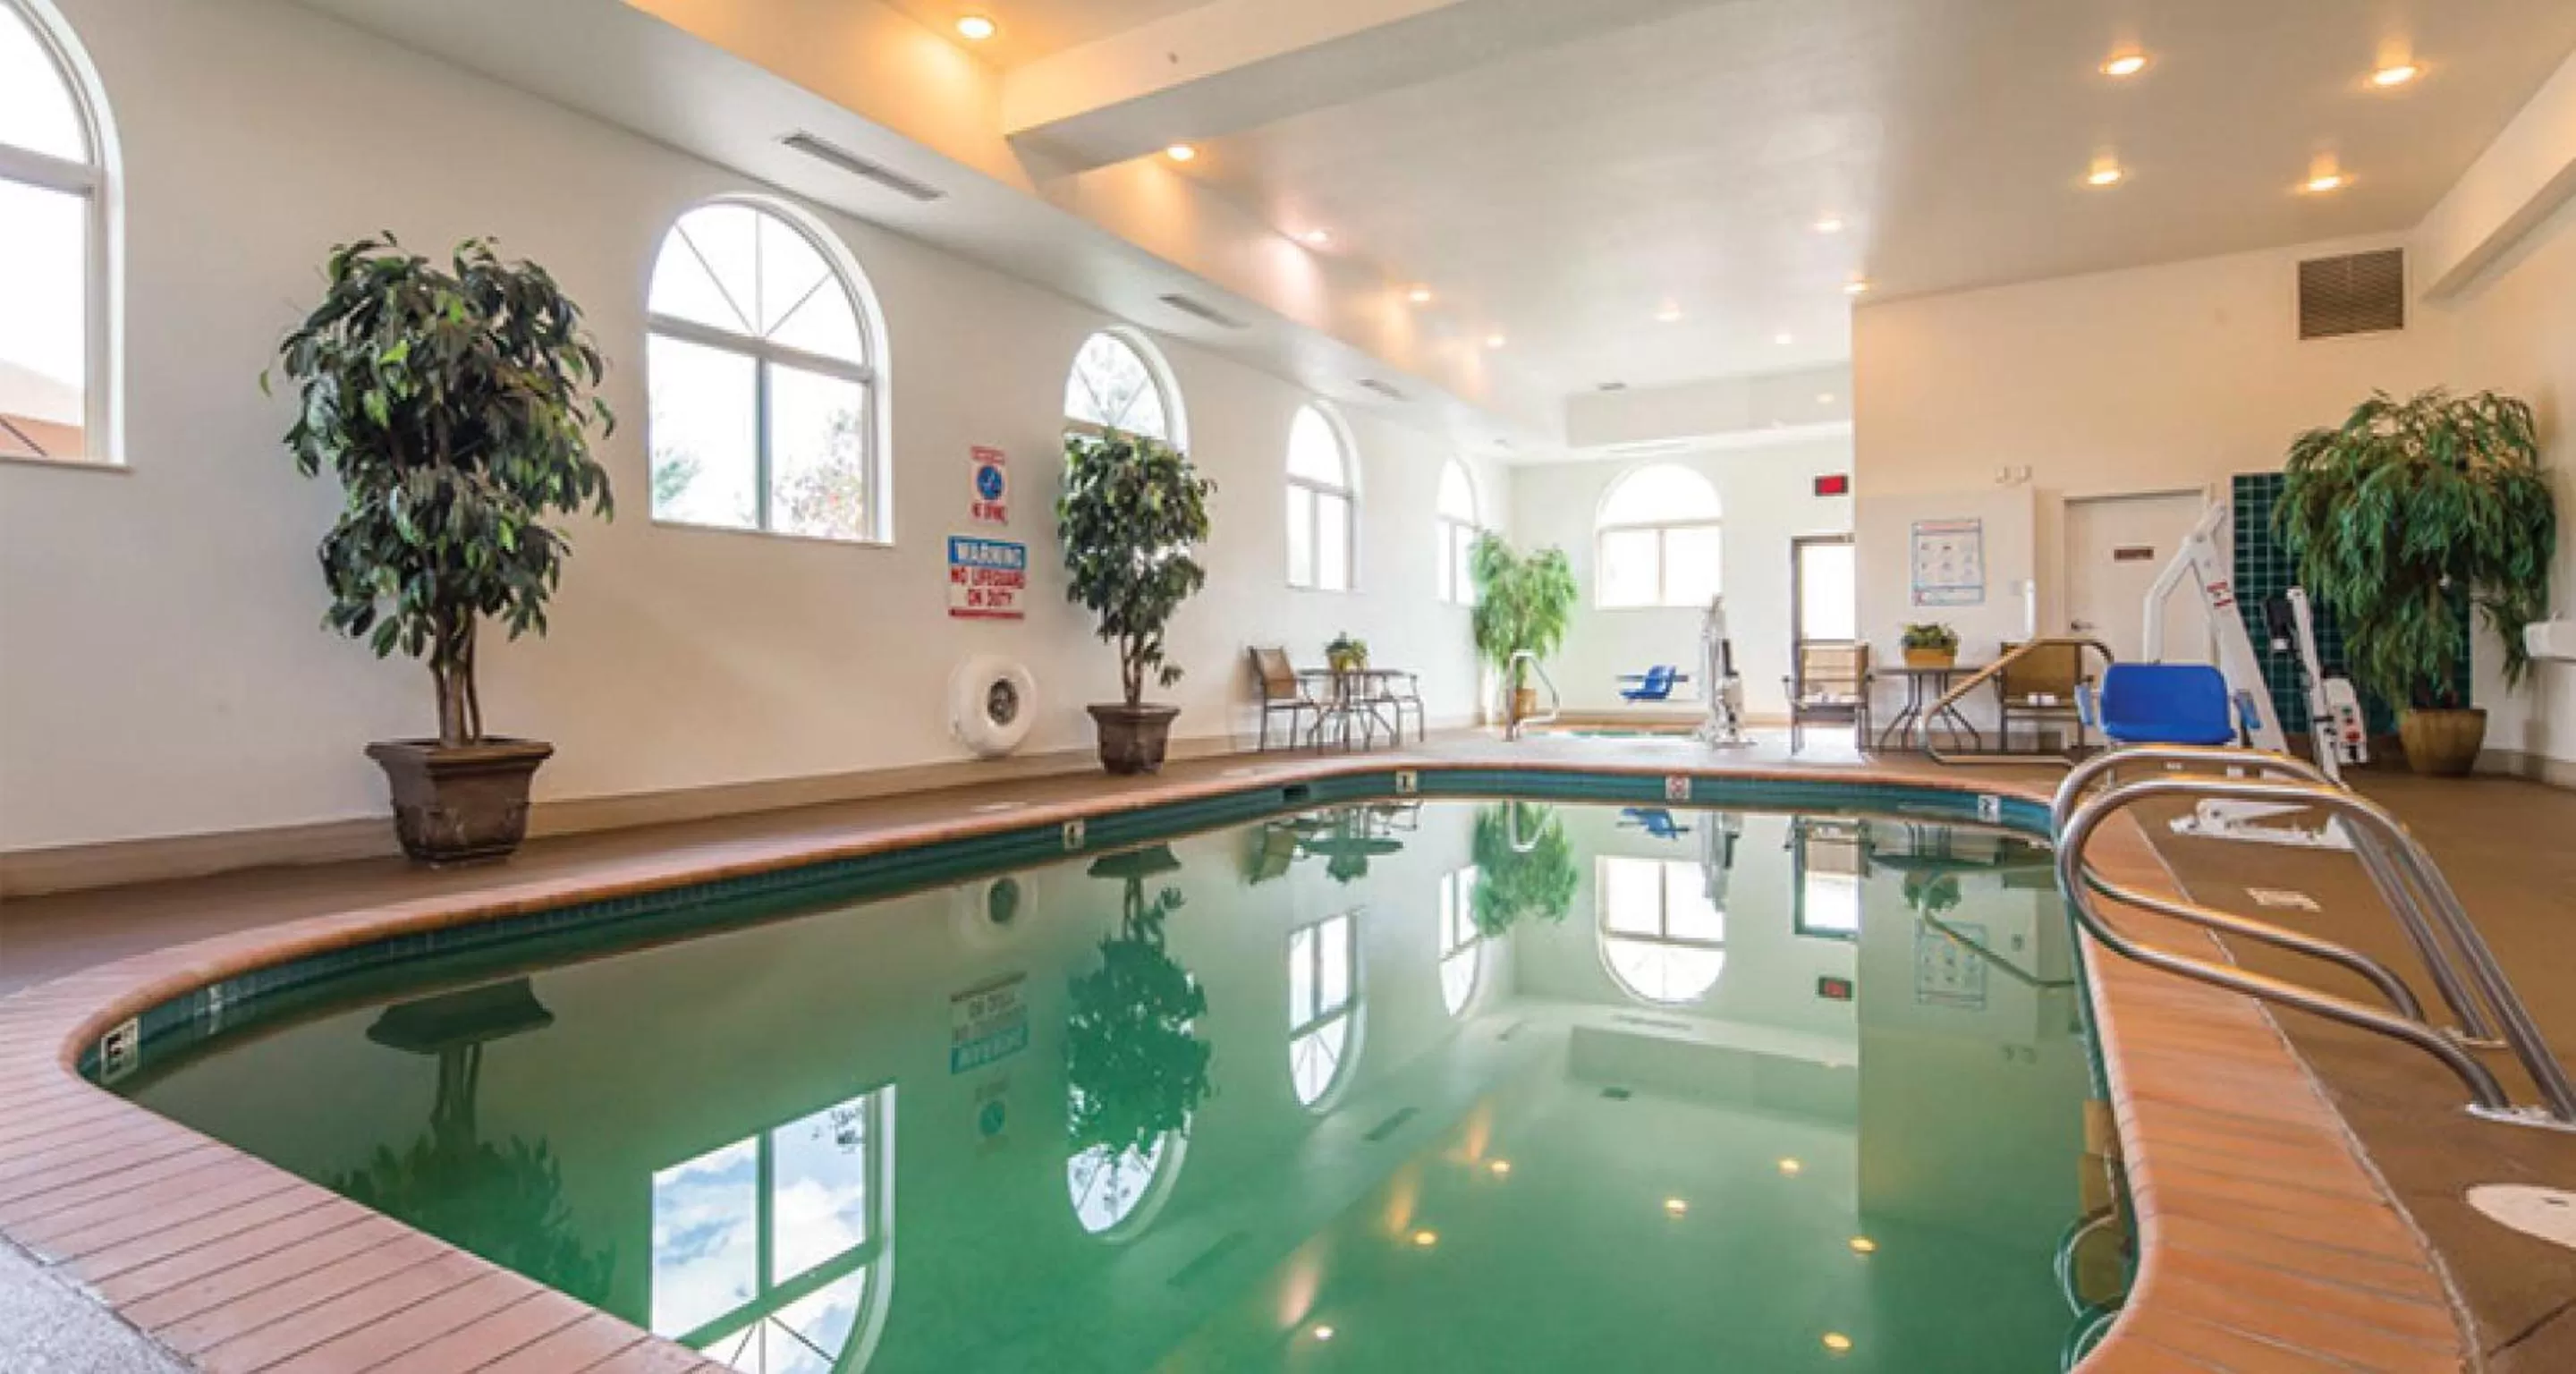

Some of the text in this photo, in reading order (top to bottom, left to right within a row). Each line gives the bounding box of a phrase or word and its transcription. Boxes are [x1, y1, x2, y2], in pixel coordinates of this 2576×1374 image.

[957, 542, 1022, 566] WARNING
[951, 567, 1024, 589] NO LIFEGUARD
[969, 589, 1013, 606] ON DUTY
